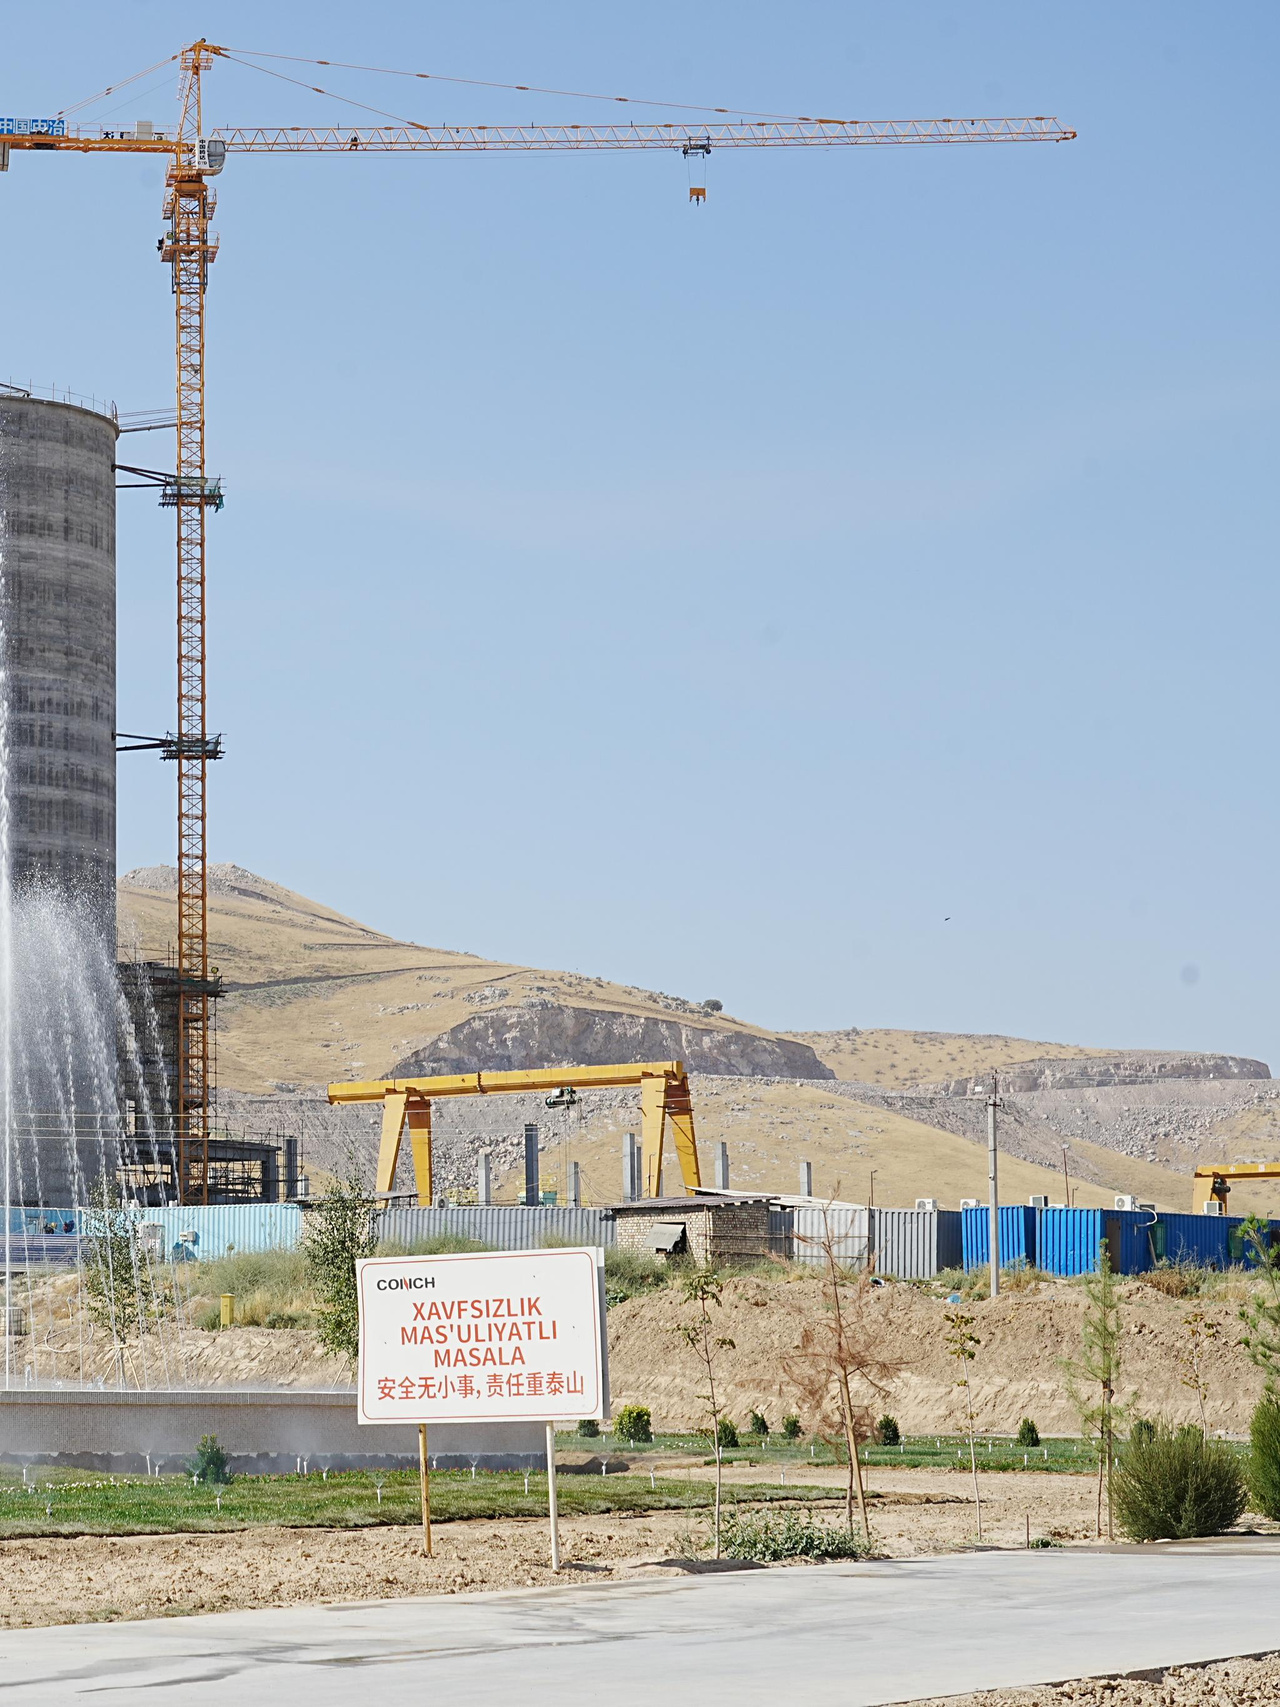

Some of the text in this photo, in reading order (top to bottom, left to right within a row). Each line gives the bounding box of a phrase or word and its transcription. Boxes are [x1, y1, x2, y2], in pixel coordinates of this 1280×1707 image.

[412, 1296, 542, 1321] XAVFSIZLIK
[400, 1320, 558, 1346] MAS'ULIYATLI
[433, 1346, 526, 1368] MASALA
